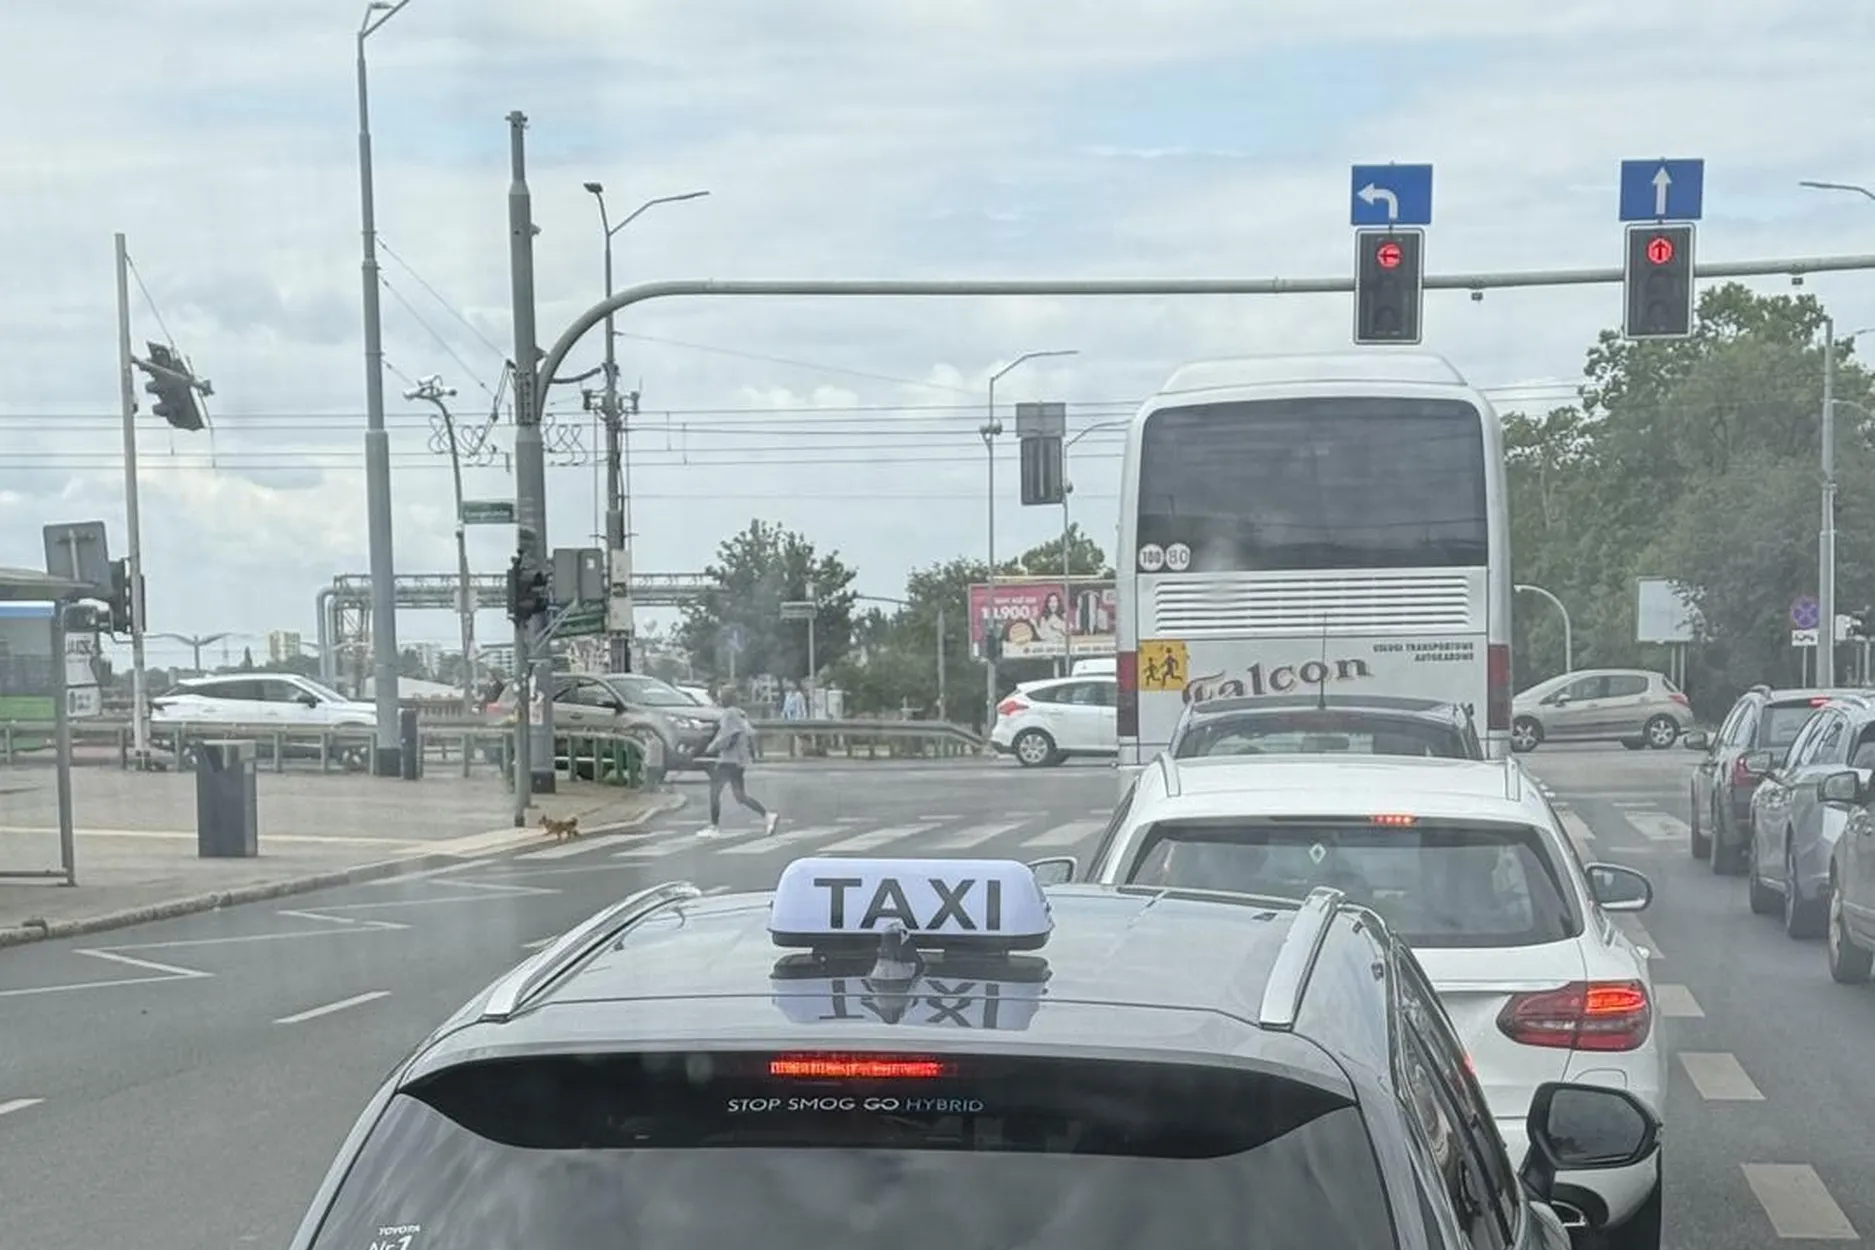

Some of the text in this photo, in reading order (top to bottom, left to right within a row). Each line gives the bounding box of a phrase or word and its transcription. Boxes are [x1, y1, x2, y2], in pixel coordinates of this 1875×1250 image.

[1169, 549, 1189, 566] 80
[813, 878, 1002, 932] TAXI
[728, 1097, 984, 1113] STOP SMOG GO HYBRID
